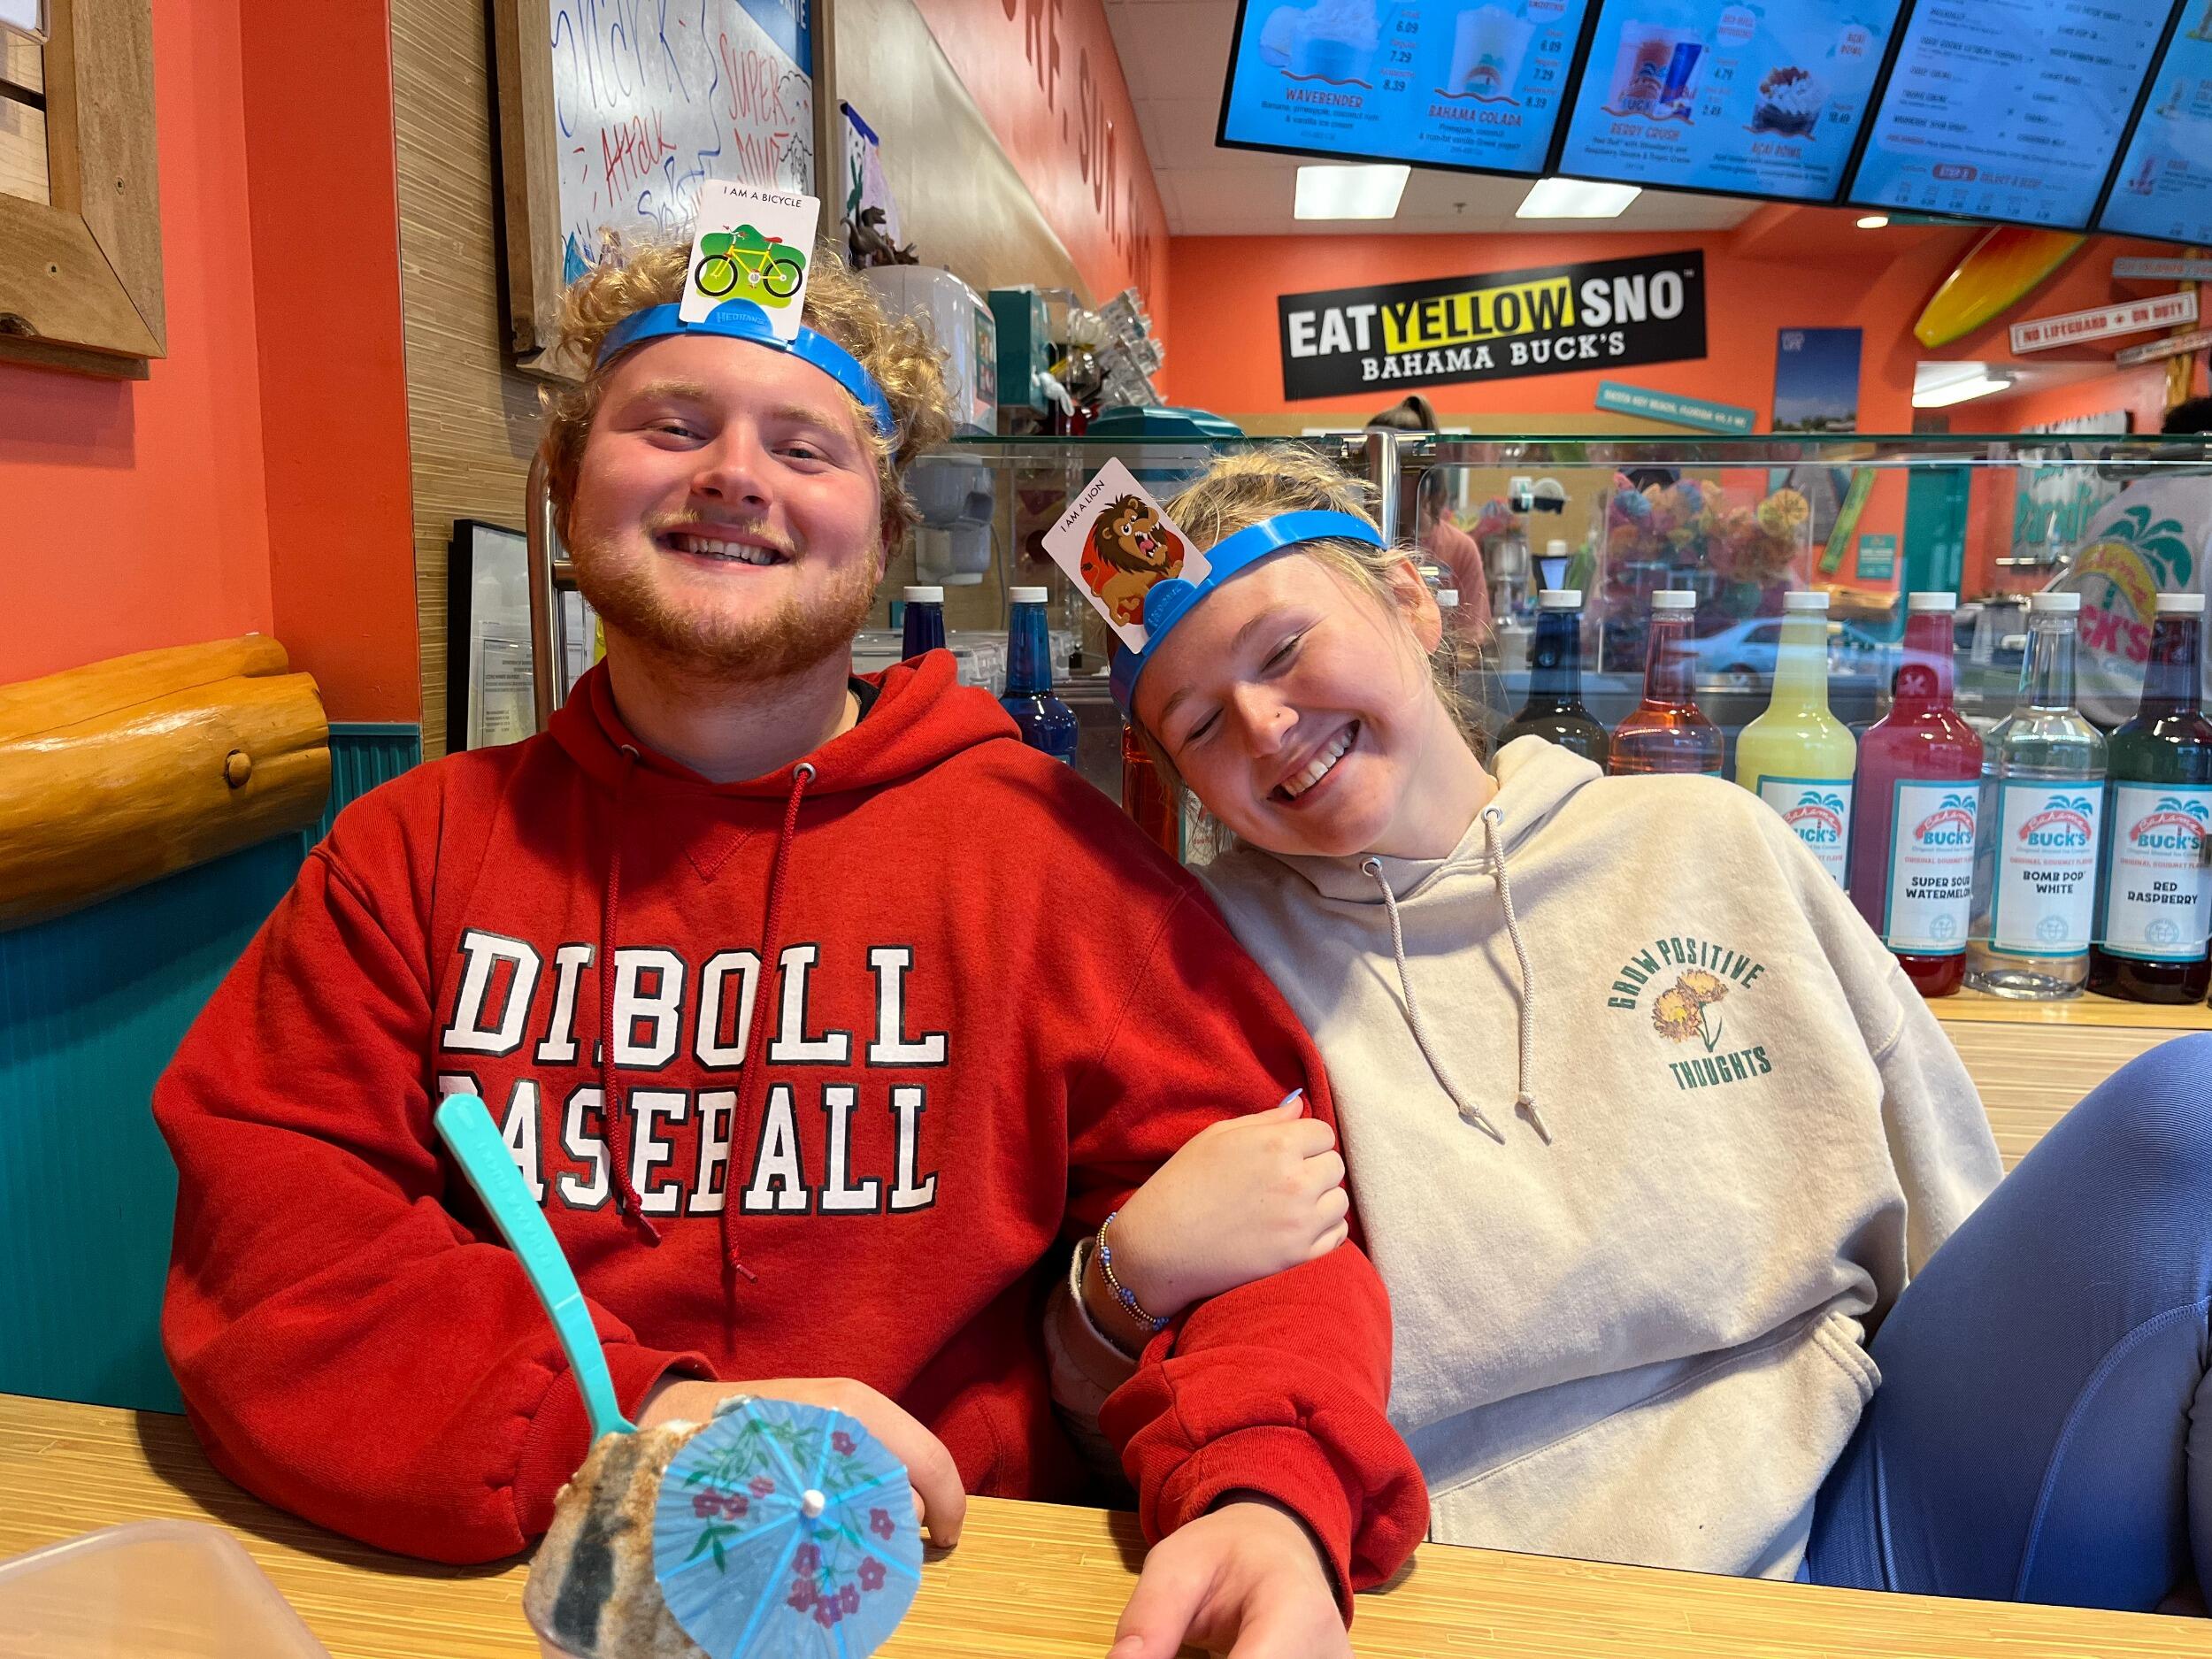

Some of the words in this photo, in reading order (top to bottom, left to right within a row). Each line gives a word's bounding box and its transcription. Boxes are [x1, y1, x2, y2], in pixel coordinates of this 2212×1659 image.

[1286, 88, 1363, 108] WAVEBENDER
[1429, 104, 1476, 122] BAHAMA
[1479, 111, 1522, 127] COLADA
[729, 188, 748, 198] AM
[750, 191, 759, 200] A
[762, 193, 803, 209] BICYCLE
[1287, 303, 1377, 358] EAT
[1386, 280, 1573, 347] YELLOW
[1580, 270, 1686, 328] SNO
[2023, 326, 2040, 342] NO
[2043, 314, 2108, 341] LIFEGUARD
[2131, 309, 2150, 324] ON
[2153, 302, 2184, 319] DUTY
[1361, 345, 1495, 382] BAHAMA
[1509, 331, 1626, 367] BUCK'S
[1060, 524, 1067, 533] I
[1065, 511, 1080, 527] AM
[1079, 503, 1087, 512] A
[1086, 480, 1105, 504] LION
[2029, 810, 2088, 831] Bahama
[2139, 812, 2202, 835] Bahama
[1794, 827, 1837, 842] UCK'S
[1923, 831, 1972, 846] BUCK'S
[2027, 832, 2086, 847] BUCK'S
[2137, 834, 2201, 849] BUCK'S
[1911, 876, 1949, 888] SUPER
[1951, 875, 1970, 887] SOUR
[2023, 871, 2060, 881] BOMB
[2153, 880, 2177, 892] RED
[2036, 884, 2074, 895] WHITE
[2127, 891, 2198, 905] RASPBERRY
[1607, 948, 1662, 1010] GROW
[1655, 937, 1765, 990] POSITIVE
[442, 926, 949, 1071] DIBOLL
[1669, 1046, 1773, 1090] THOUGHTS
